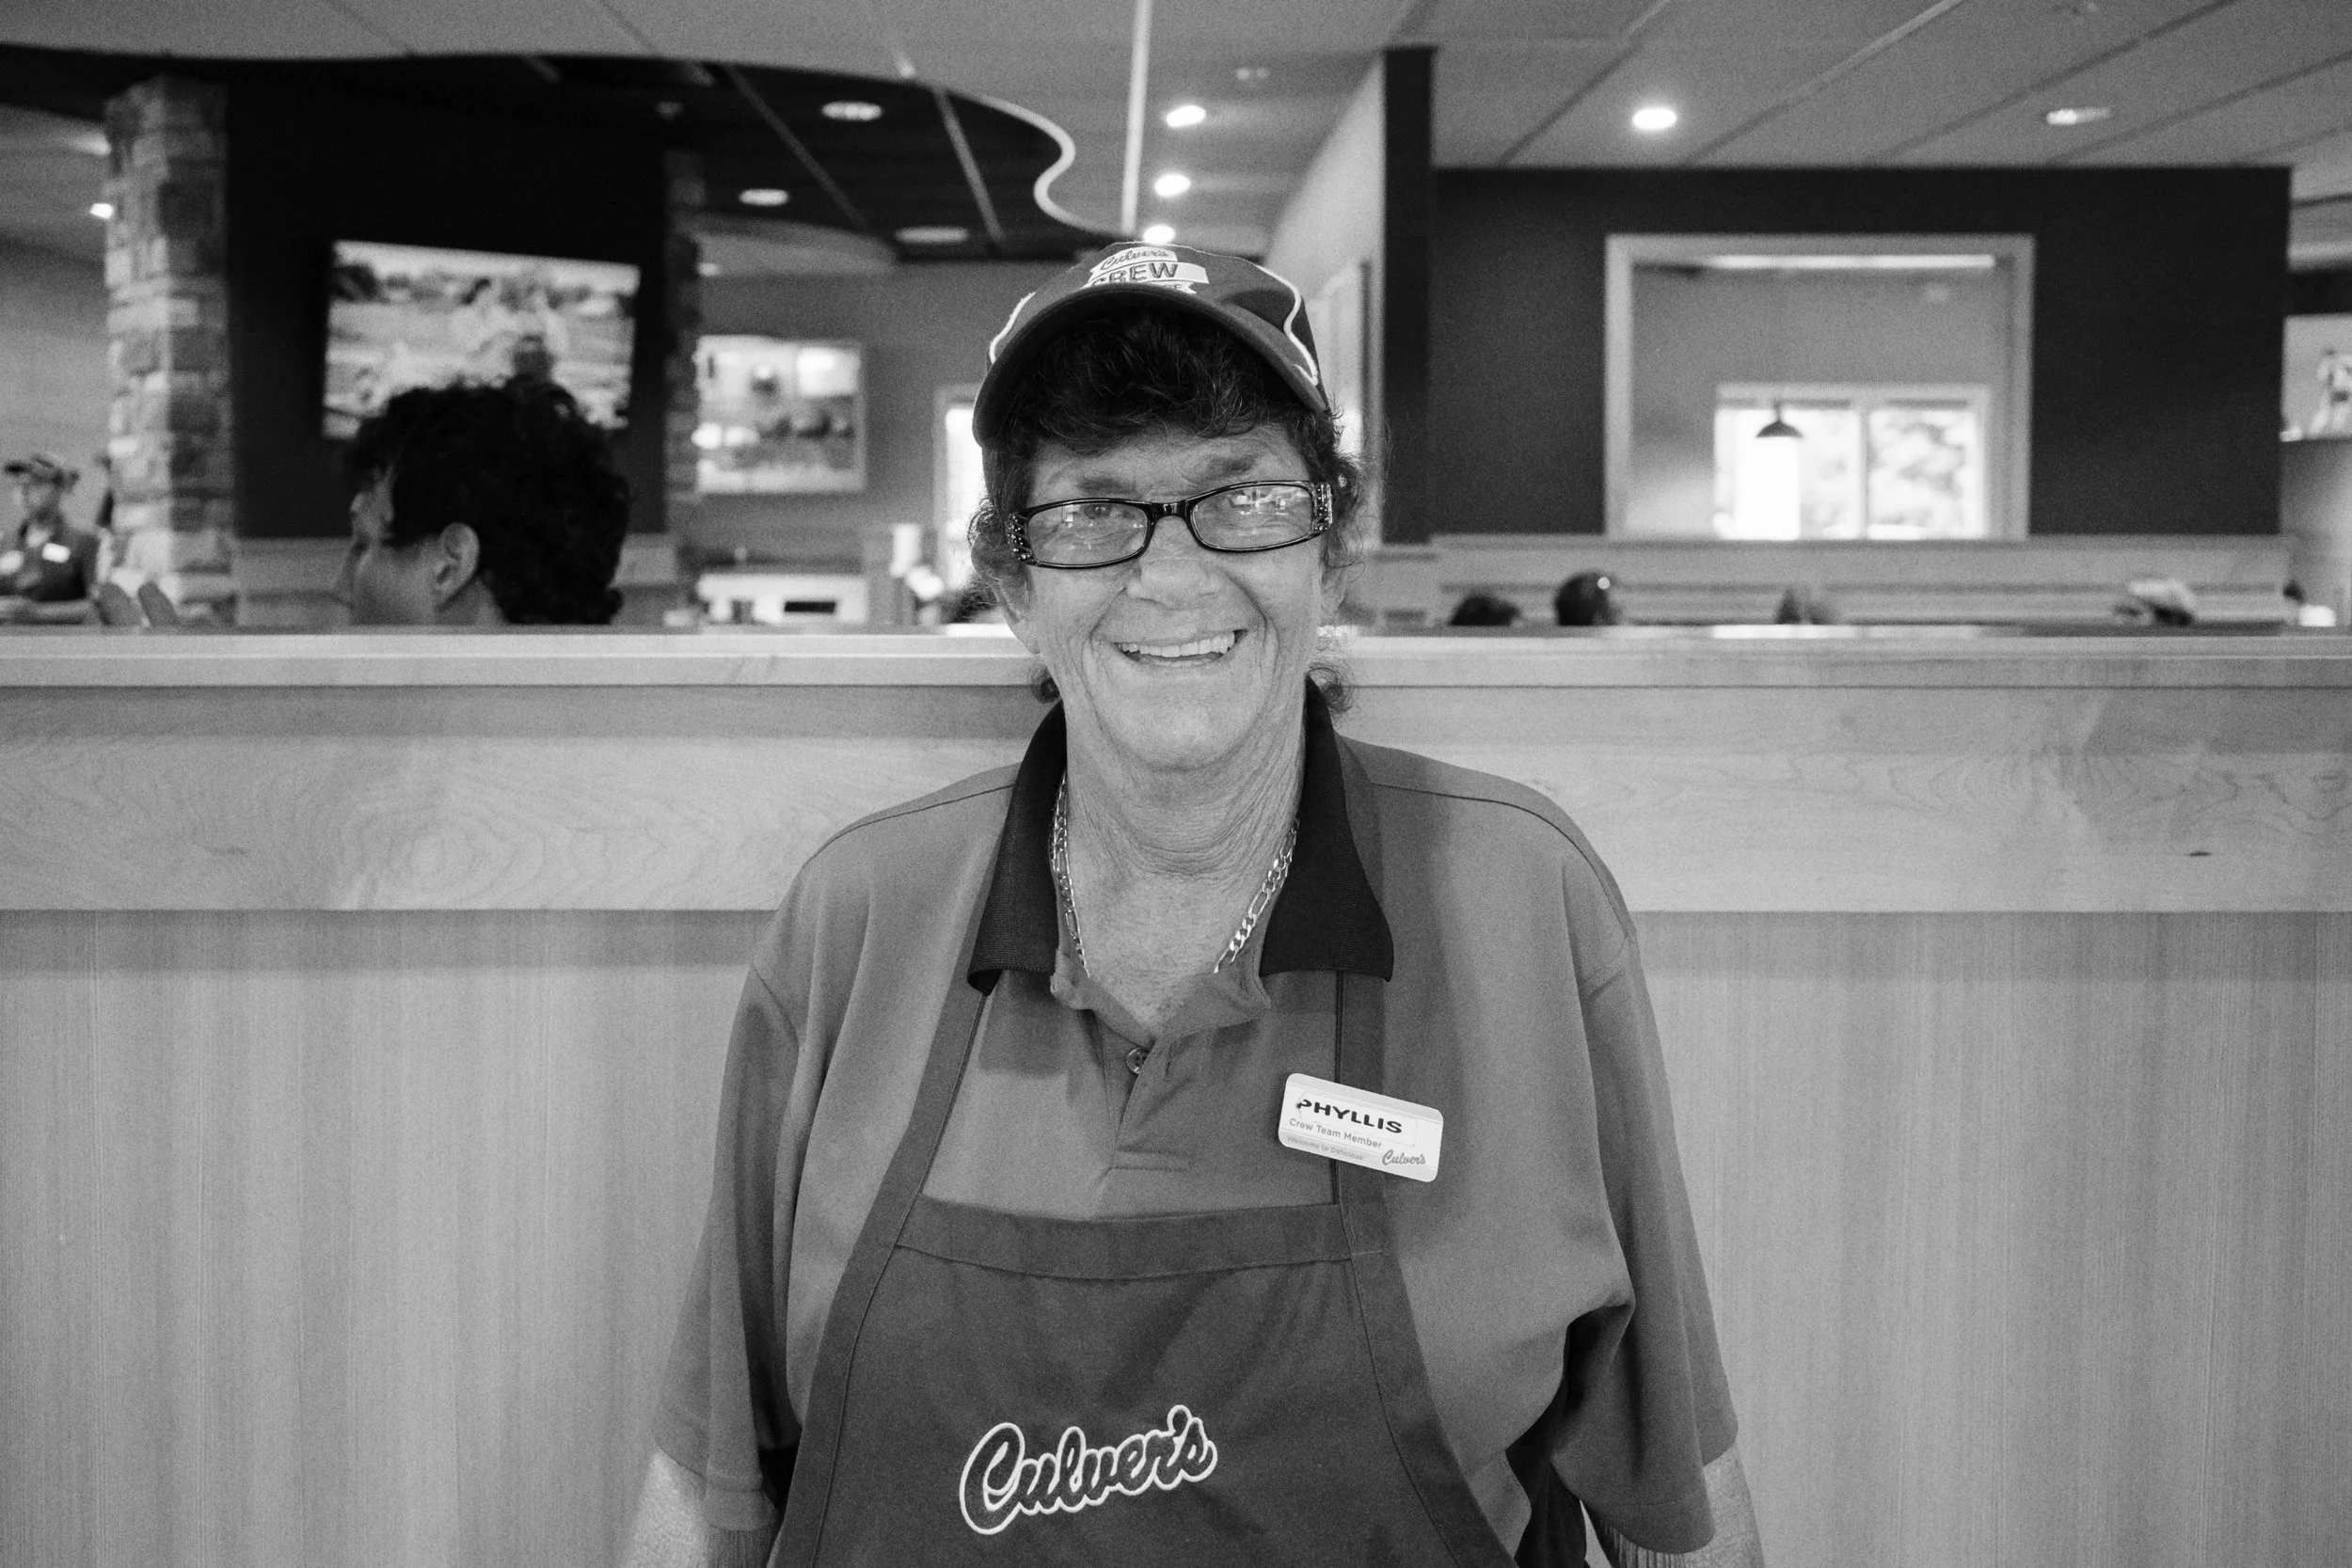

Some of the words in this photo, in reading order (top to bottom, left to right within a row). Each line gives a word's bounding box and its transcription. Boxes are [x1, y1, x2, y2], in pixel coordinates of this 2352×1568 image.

[1100, 250, 1168, 270] Culver's
[1296, 1099, 1403, 1134] PHYLLIS
[1287, 1135, 1320, 1148] Welcome
[1289, 1117, 1314, 1132] Crew
[1316, 1124, 1342, 1139] Team
[1343, 1132, 1383, 1149] Member
[1381, 1148, 1427, 1166] Culver's
[960, 1404, 1217, 1535] Culver's
